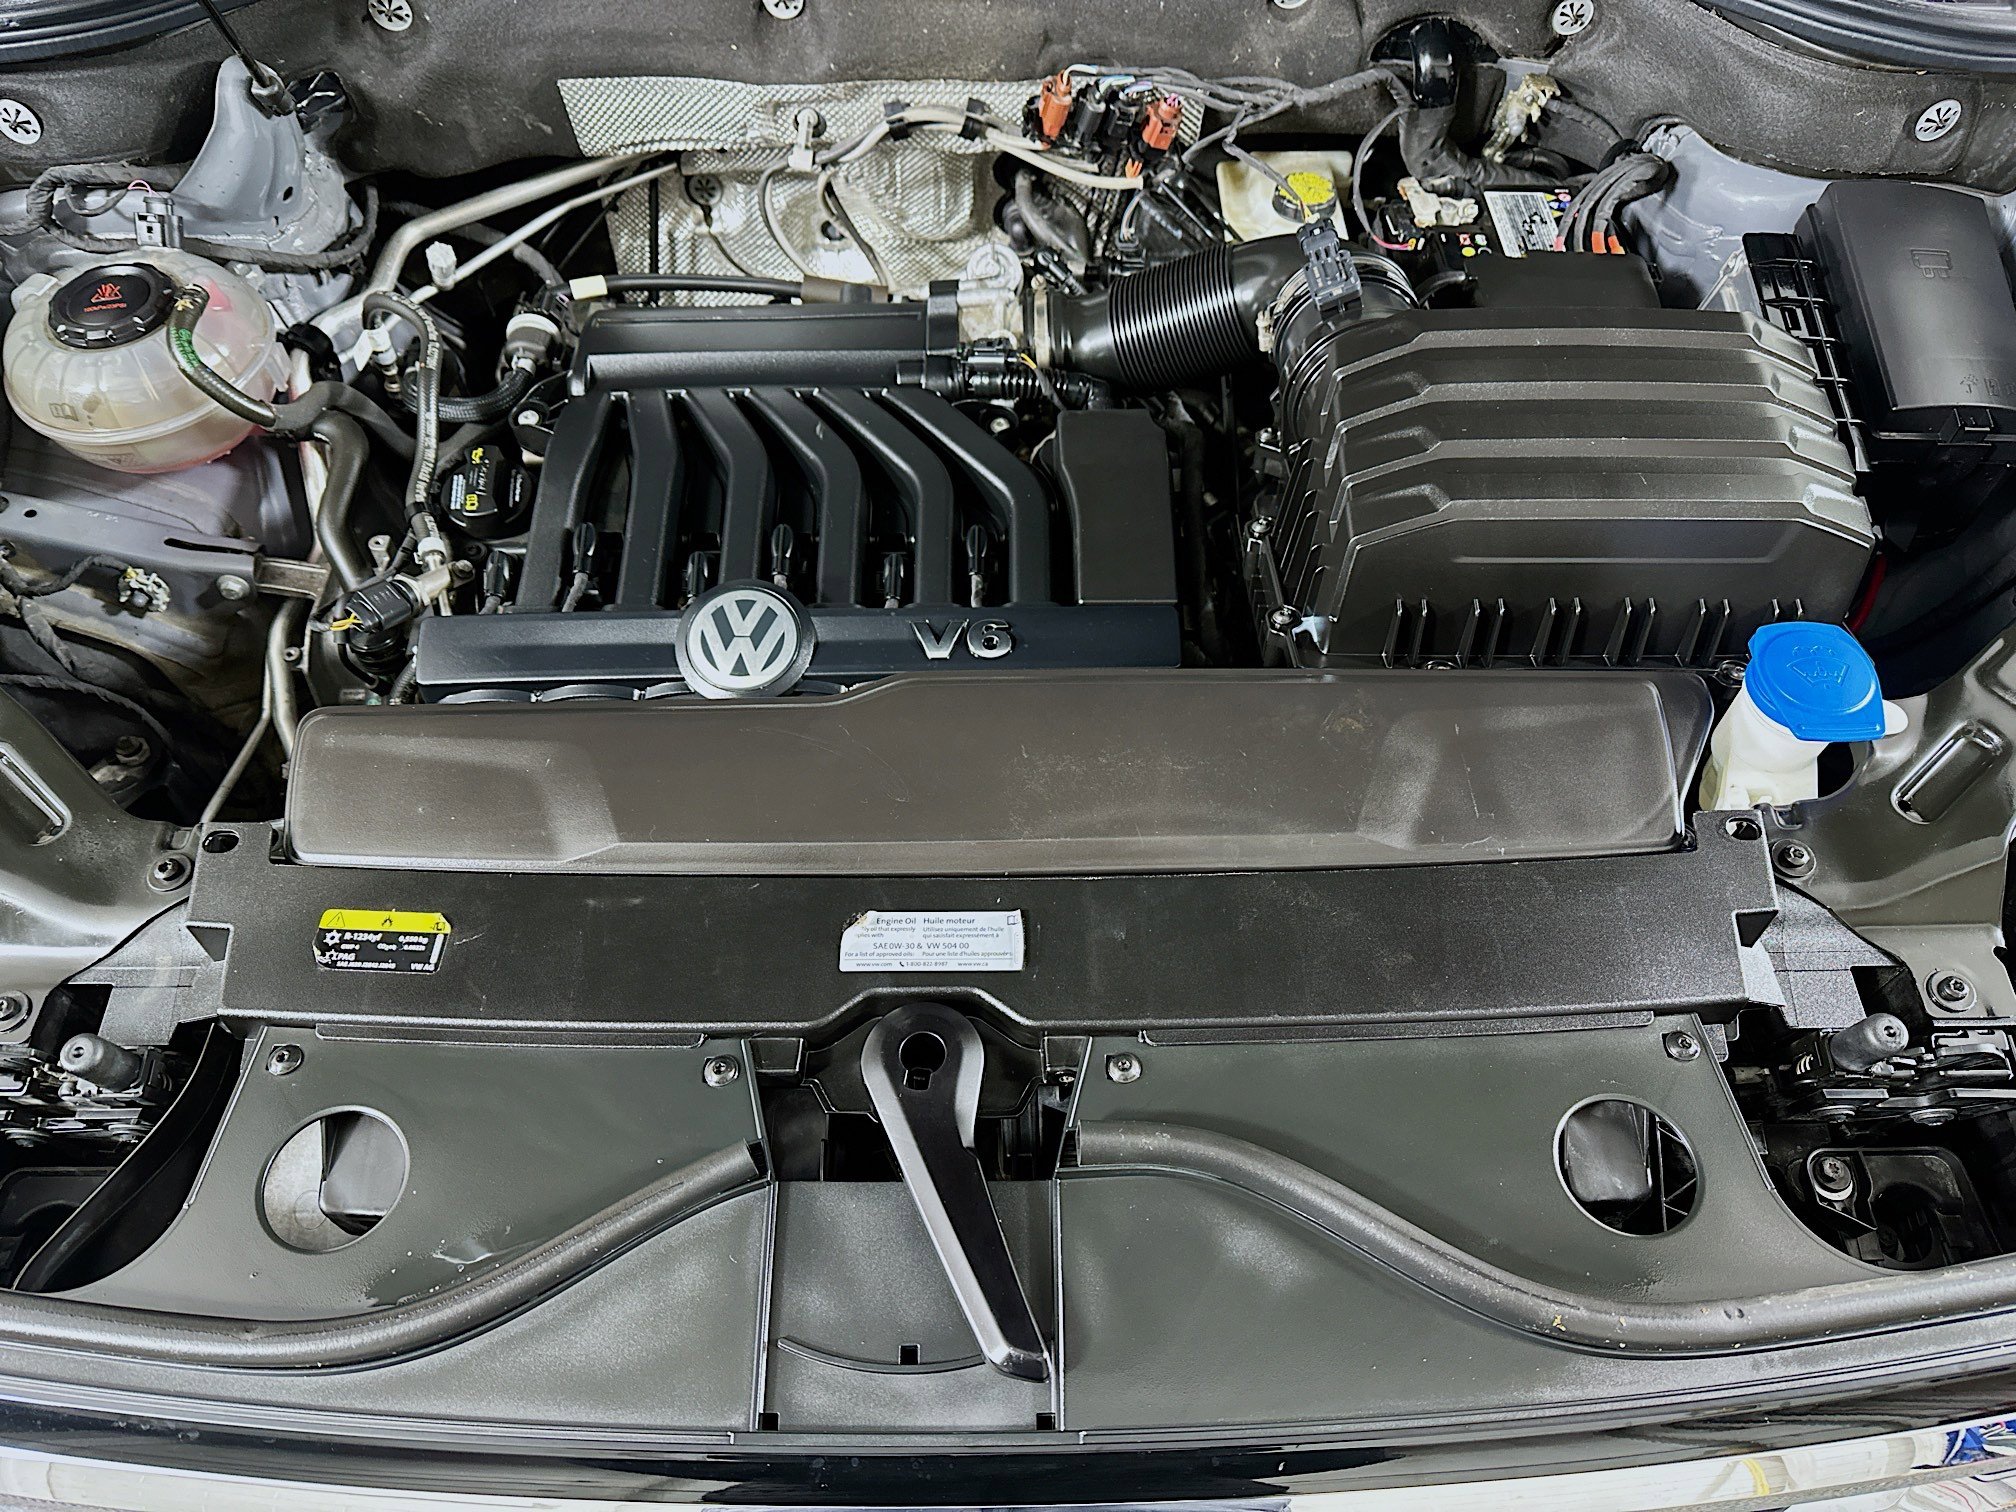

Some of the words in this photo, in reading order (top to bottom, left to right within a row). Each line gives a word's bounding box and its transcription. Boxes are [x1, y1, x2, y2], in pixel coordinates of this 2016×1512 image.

[688, 590, 797, 689] VW
[909, 618, 1014, 660] V6
[876, 917, 904, 926] Engine
[904, 917, 917, 925] Oil
[888, 942, 915, 950] 0W-30
